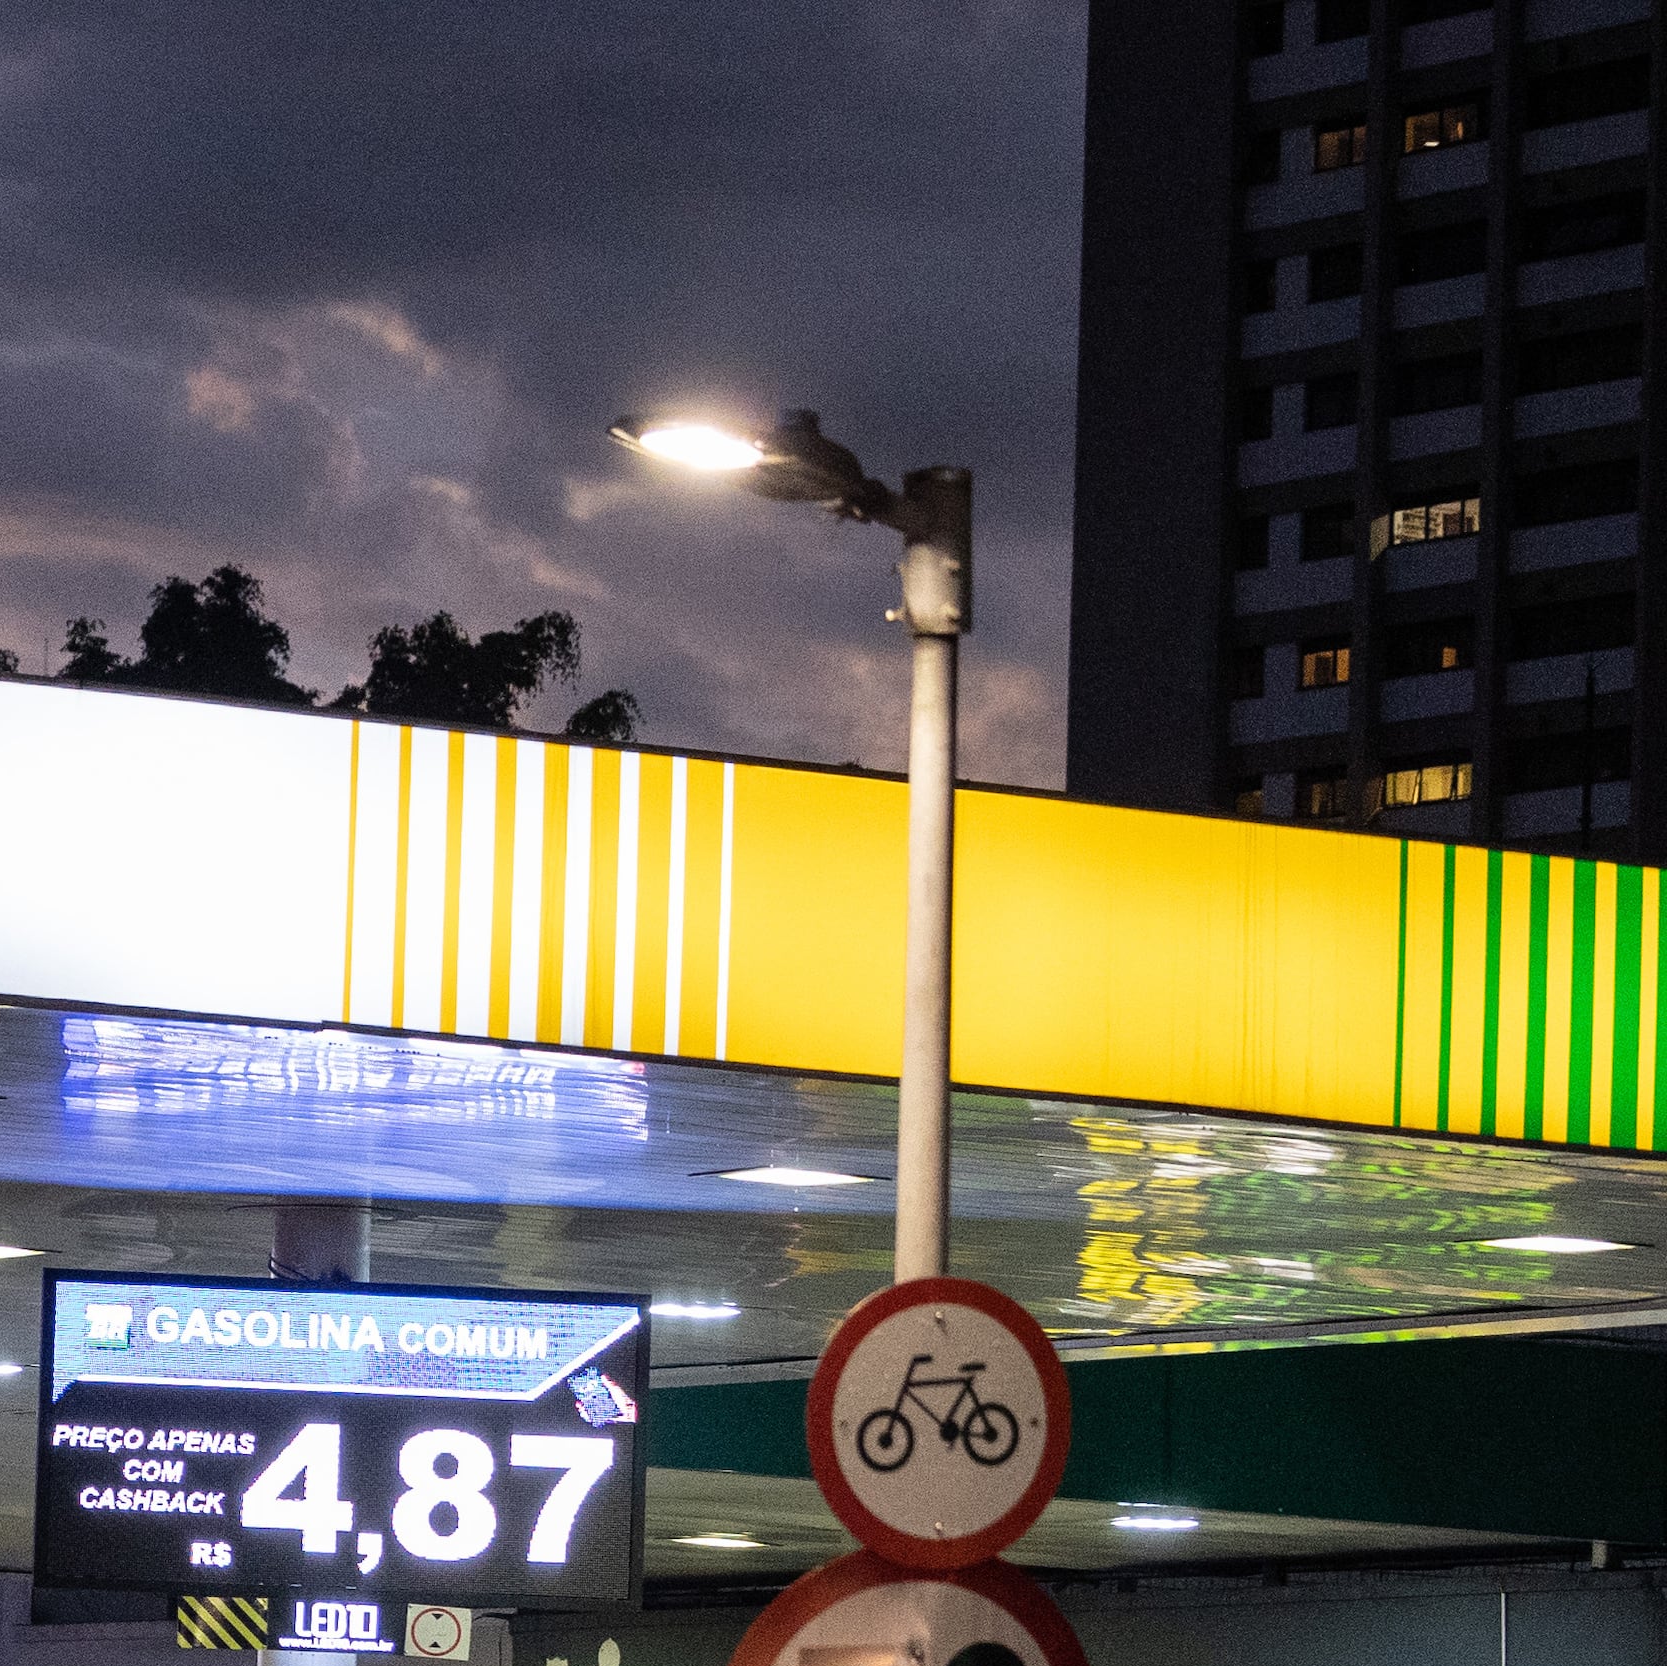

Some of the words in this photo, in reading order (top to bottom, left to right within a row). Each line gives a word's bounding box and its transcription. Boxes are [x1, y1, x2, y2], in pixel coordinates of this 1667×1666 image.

[147, 1305, 385, 1353] GASOLINA
[397, 1321, 548, 1361] COMUM
[53, 1423, 143, 1454] PREÇO
[147, 1429, 256, 1456] APENAS
[122, 1458, 184, 1484] COM
[79, 1486, 225, 1516] CASHBACK
[240, 1423, 615, 1575] 4,87
[190, 1541, 232, 1569] R$
